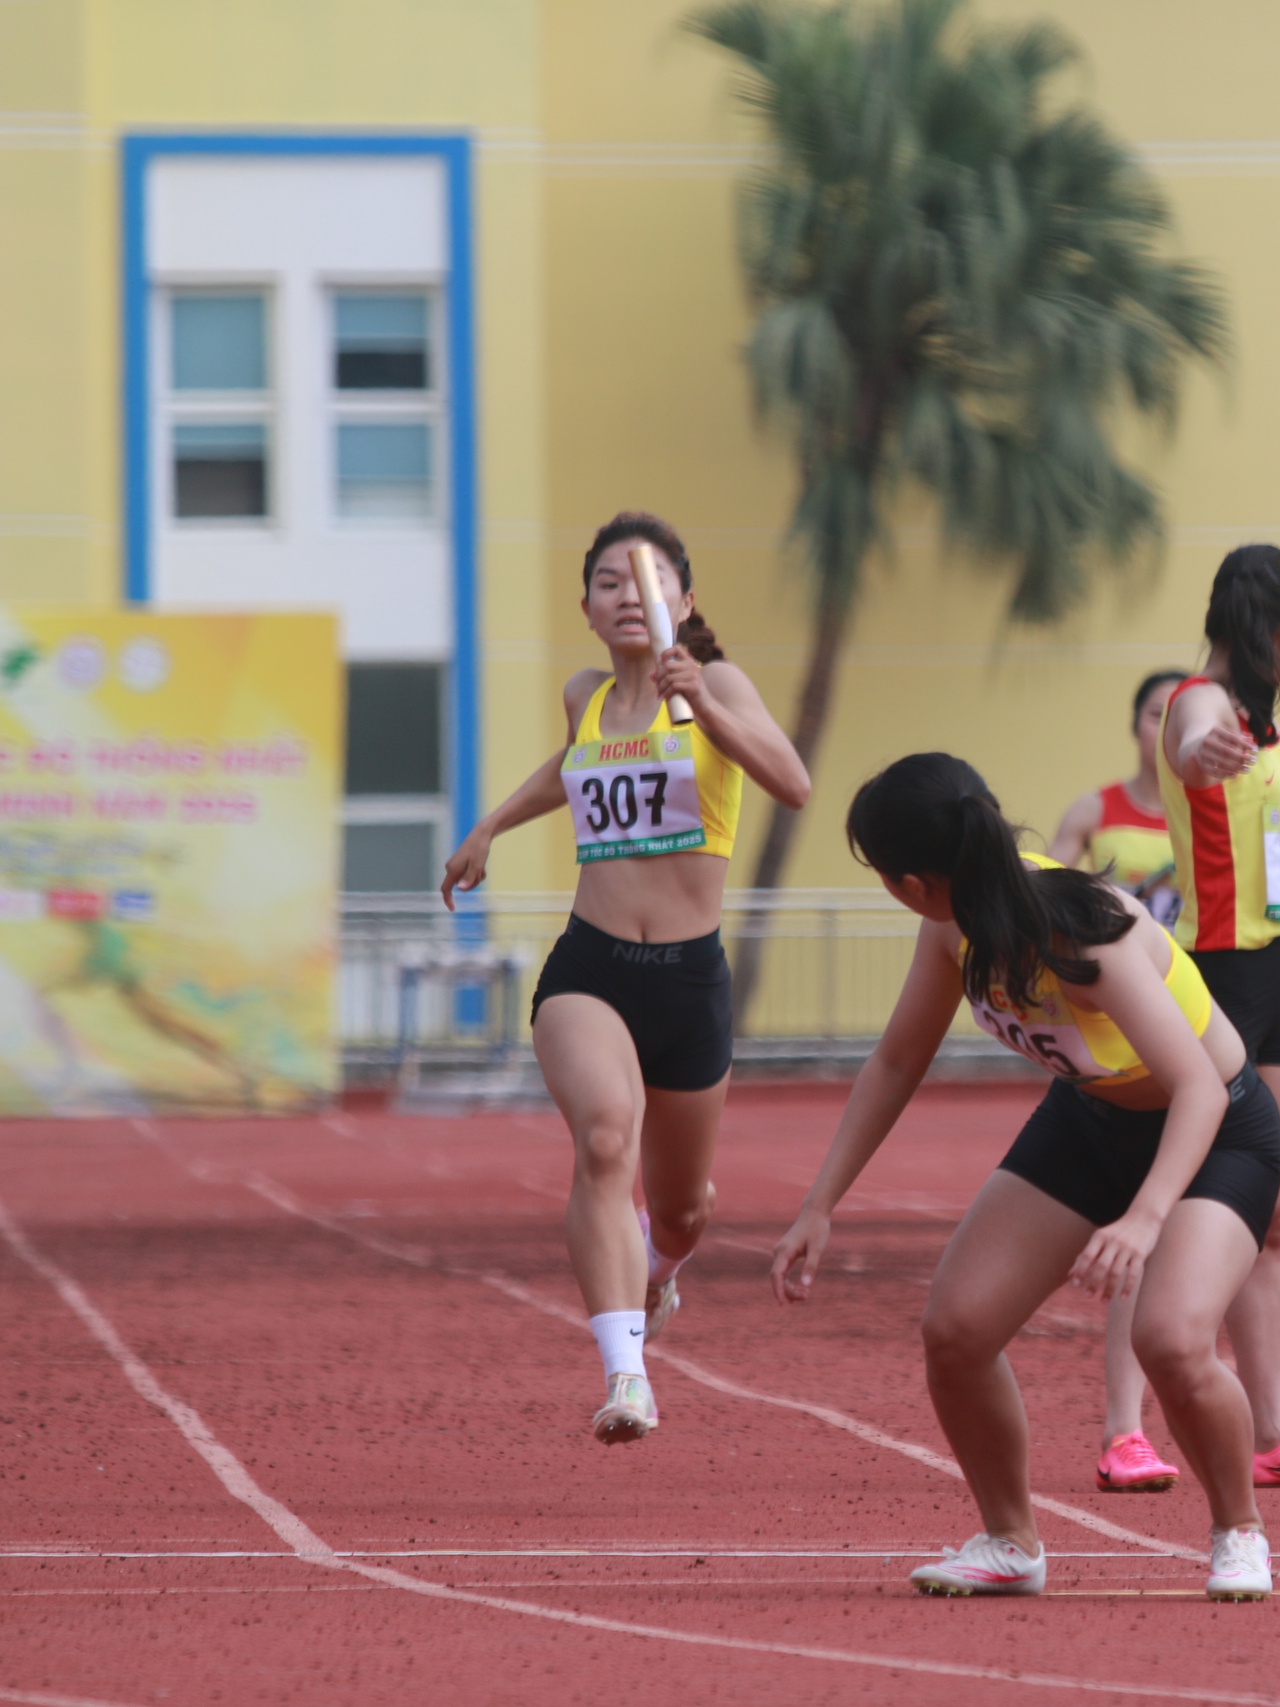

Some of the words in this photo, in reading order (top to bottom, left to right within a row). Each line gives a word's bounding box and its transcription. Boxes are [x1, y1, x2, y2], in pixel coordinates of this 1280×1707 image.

[599, 738, 649, 762] HCMC
[582, 772, 668, 834] 307
[677, 833, 702, 848] 2025
[612, 942, 684, 965] NIKE
